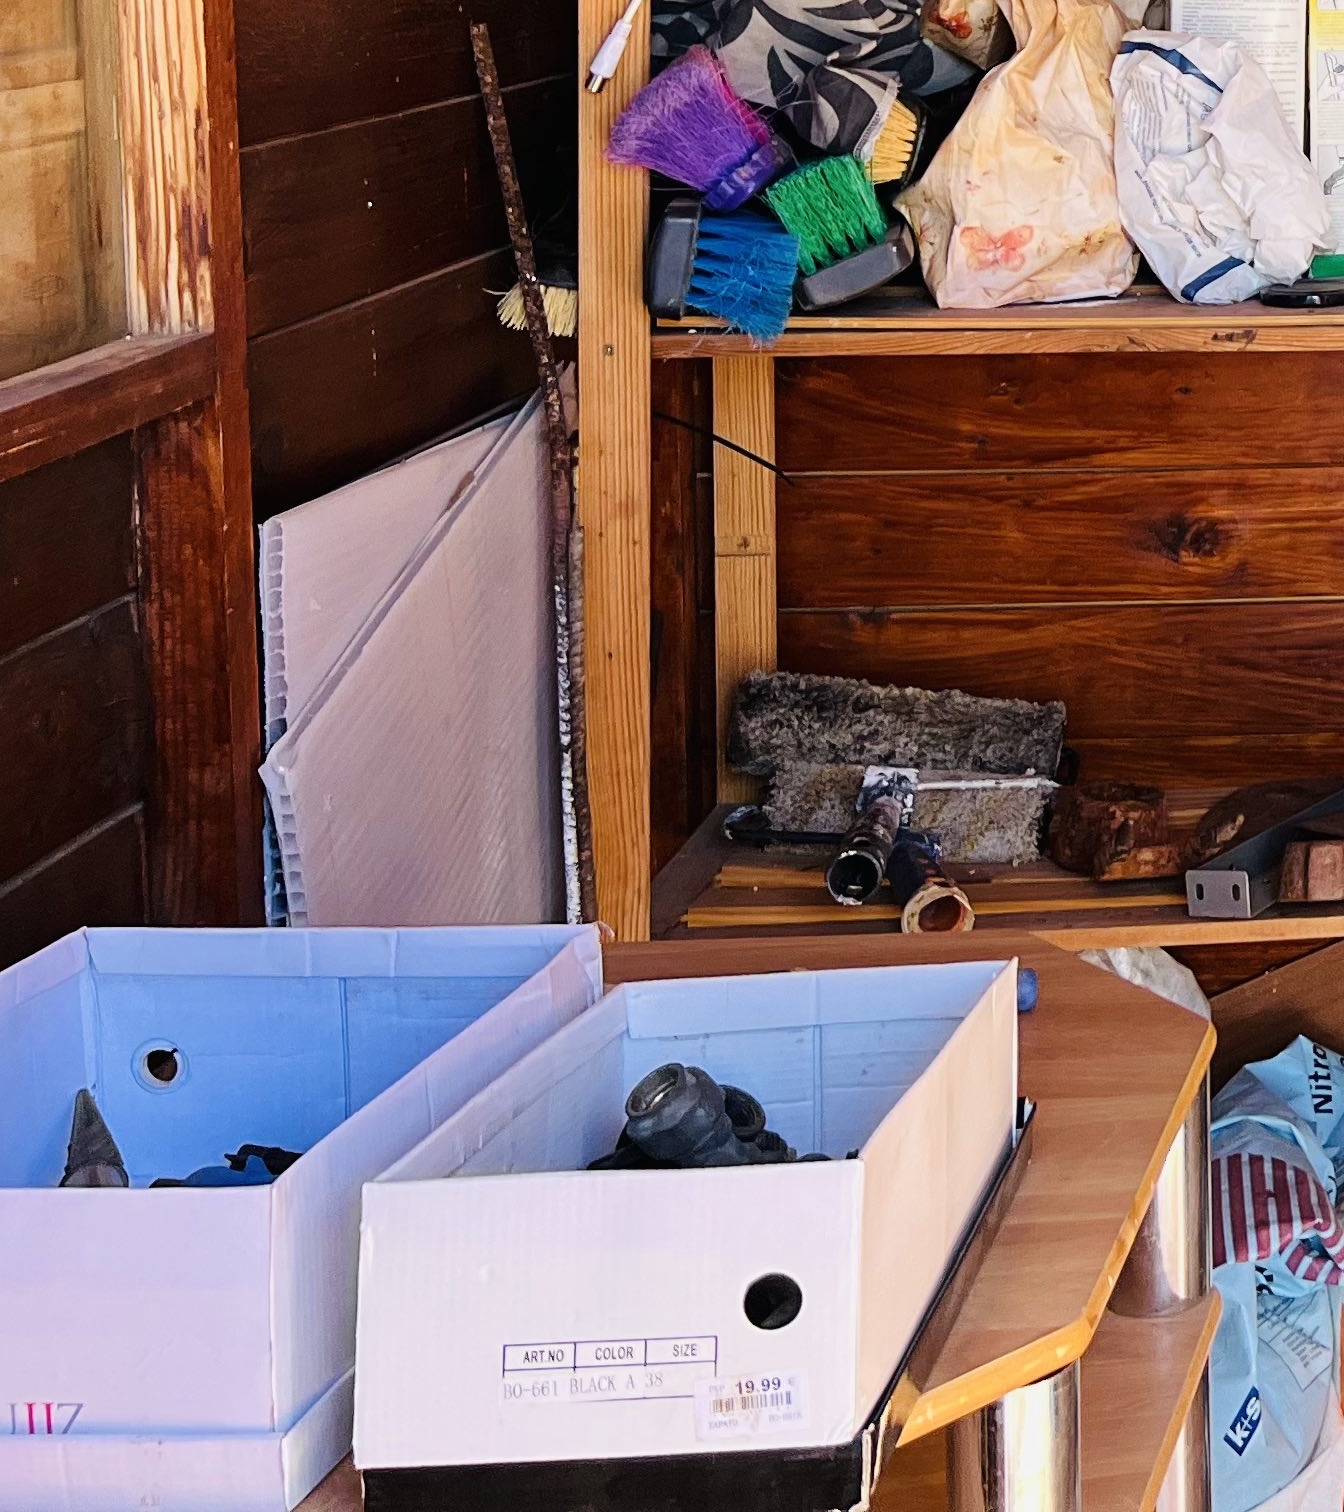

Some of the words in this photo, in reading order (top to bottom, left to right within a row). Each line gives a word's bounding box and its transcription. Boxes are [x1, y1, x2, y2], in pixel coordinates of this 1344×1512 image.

[522, 1349, 565, 1364] ART.NO
[594, 1346, 635, 1362] COLOR
[671, 1343, 699, 1358] SIZE
[503, 1378, 559, 1400] BO-661
[569, 1374, 617, 1395] BLACK
[625, 1373, 637, 1390] A
[645, 1370, 664, 1388] 38
[735, 1376, 781, 1395] 19.99
